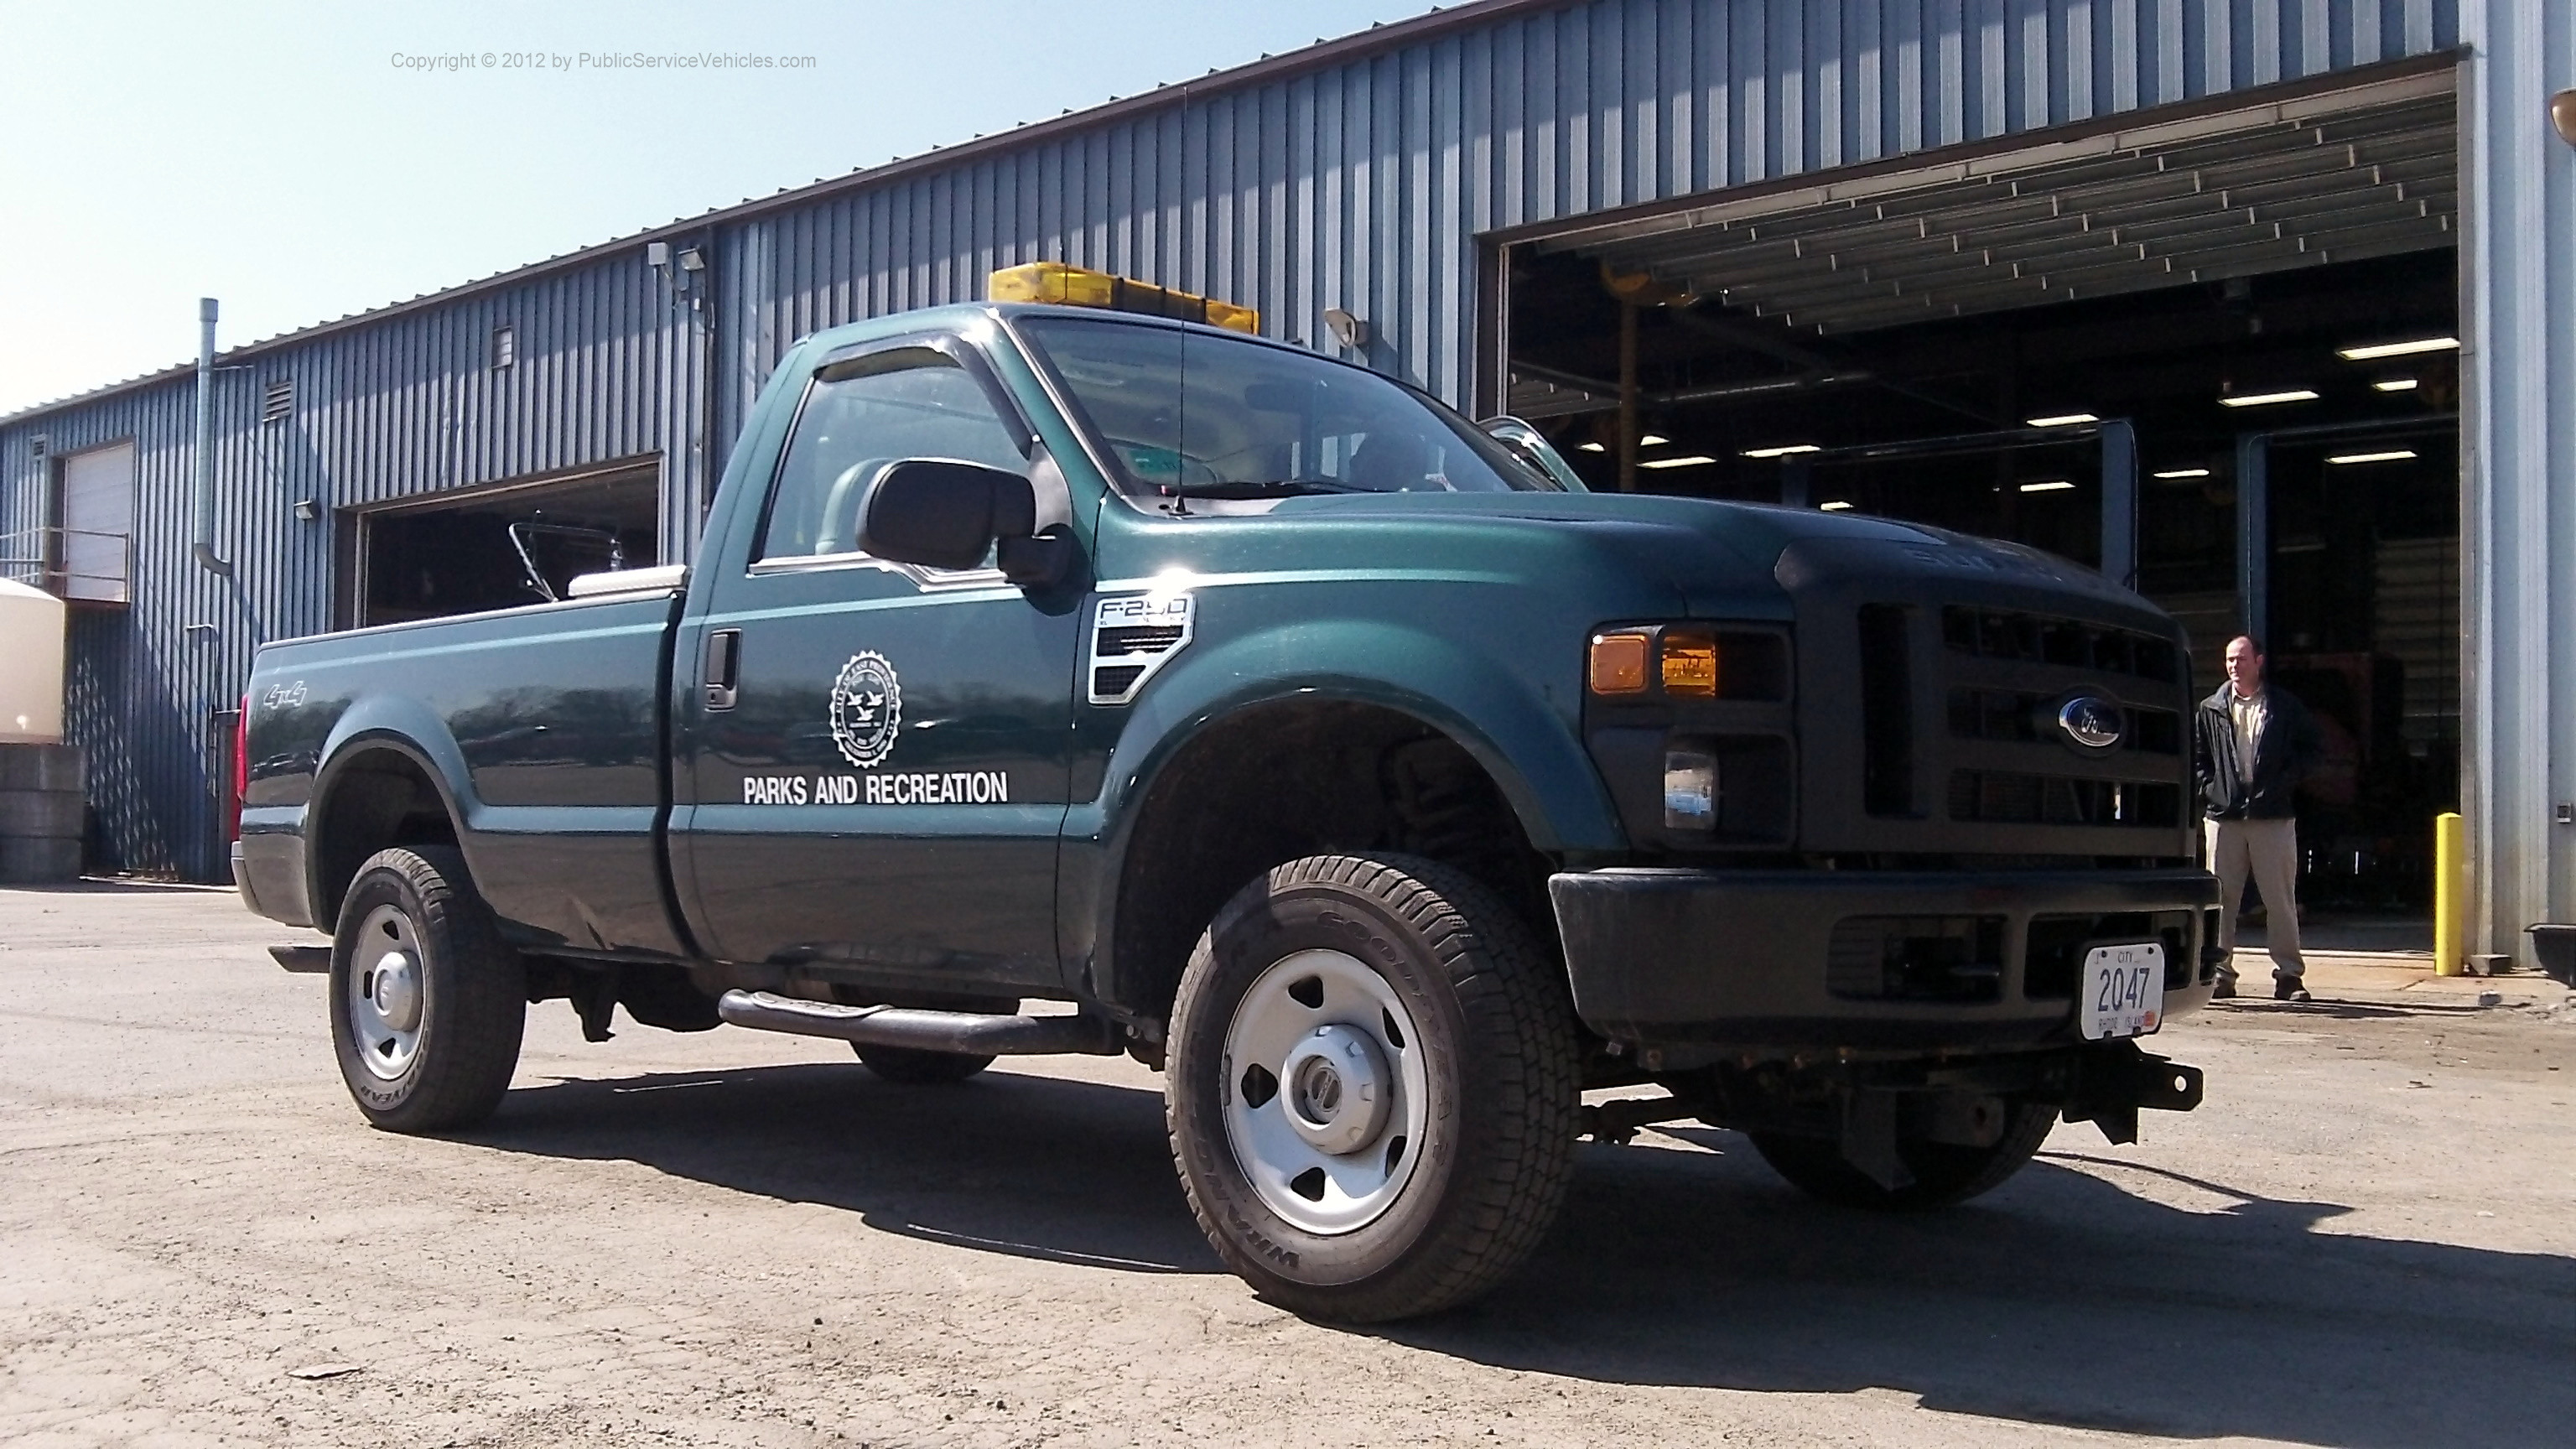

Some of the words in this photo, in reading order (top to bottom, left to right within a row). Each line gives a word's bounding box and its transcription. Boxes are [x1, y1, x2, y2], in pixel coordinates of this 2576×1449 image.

[263, 681, 307, 710] 4x4
[744, 776, 807, 806] PARKS
[814, 776, 858, 805] AND
[866, 771, 1008, 804] RECREATION
[2117, 951, 2133, 963] CITY
[2098, 968, 2150, 1011] 2047
